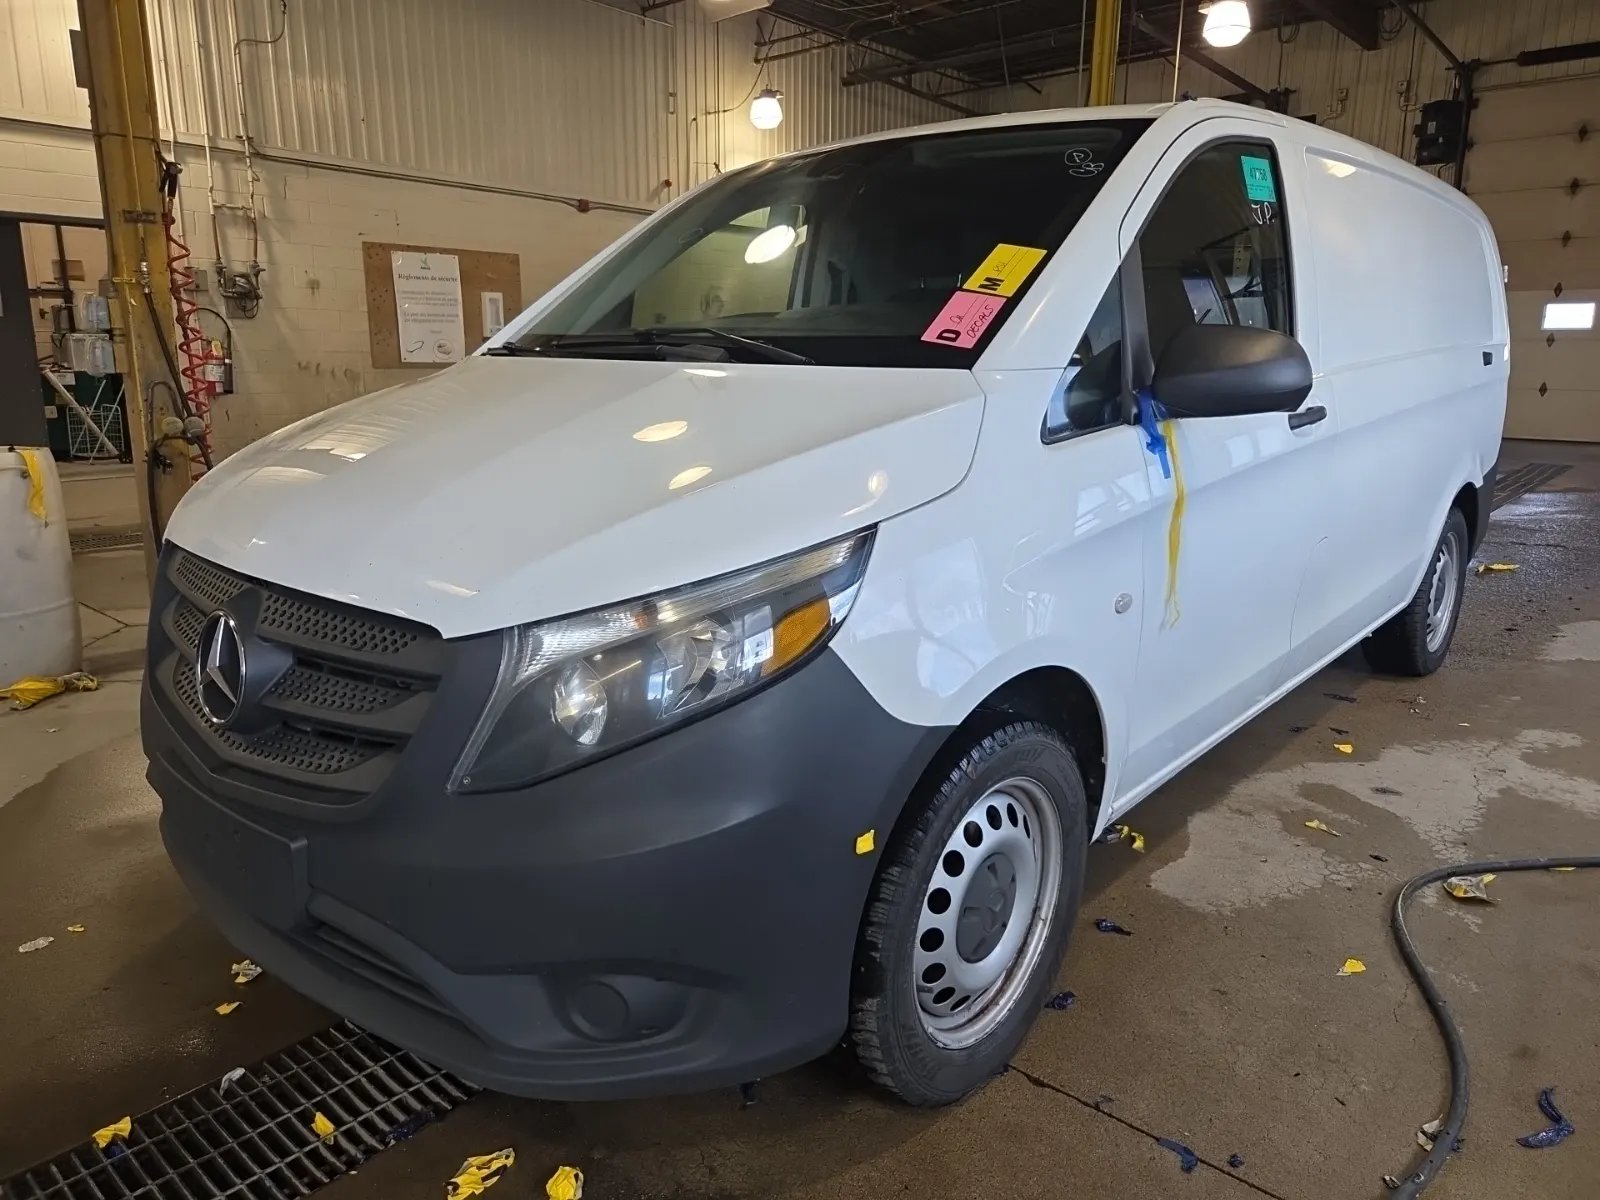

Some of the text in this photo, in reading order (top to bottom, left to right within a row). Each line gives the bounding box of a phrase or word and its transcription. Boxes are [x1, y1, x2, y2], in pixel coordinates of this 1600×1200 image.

[976, 276, 1006, 292] M
[966, 304, 994, 339] DECALS
[935, 328, 962, 343] D
